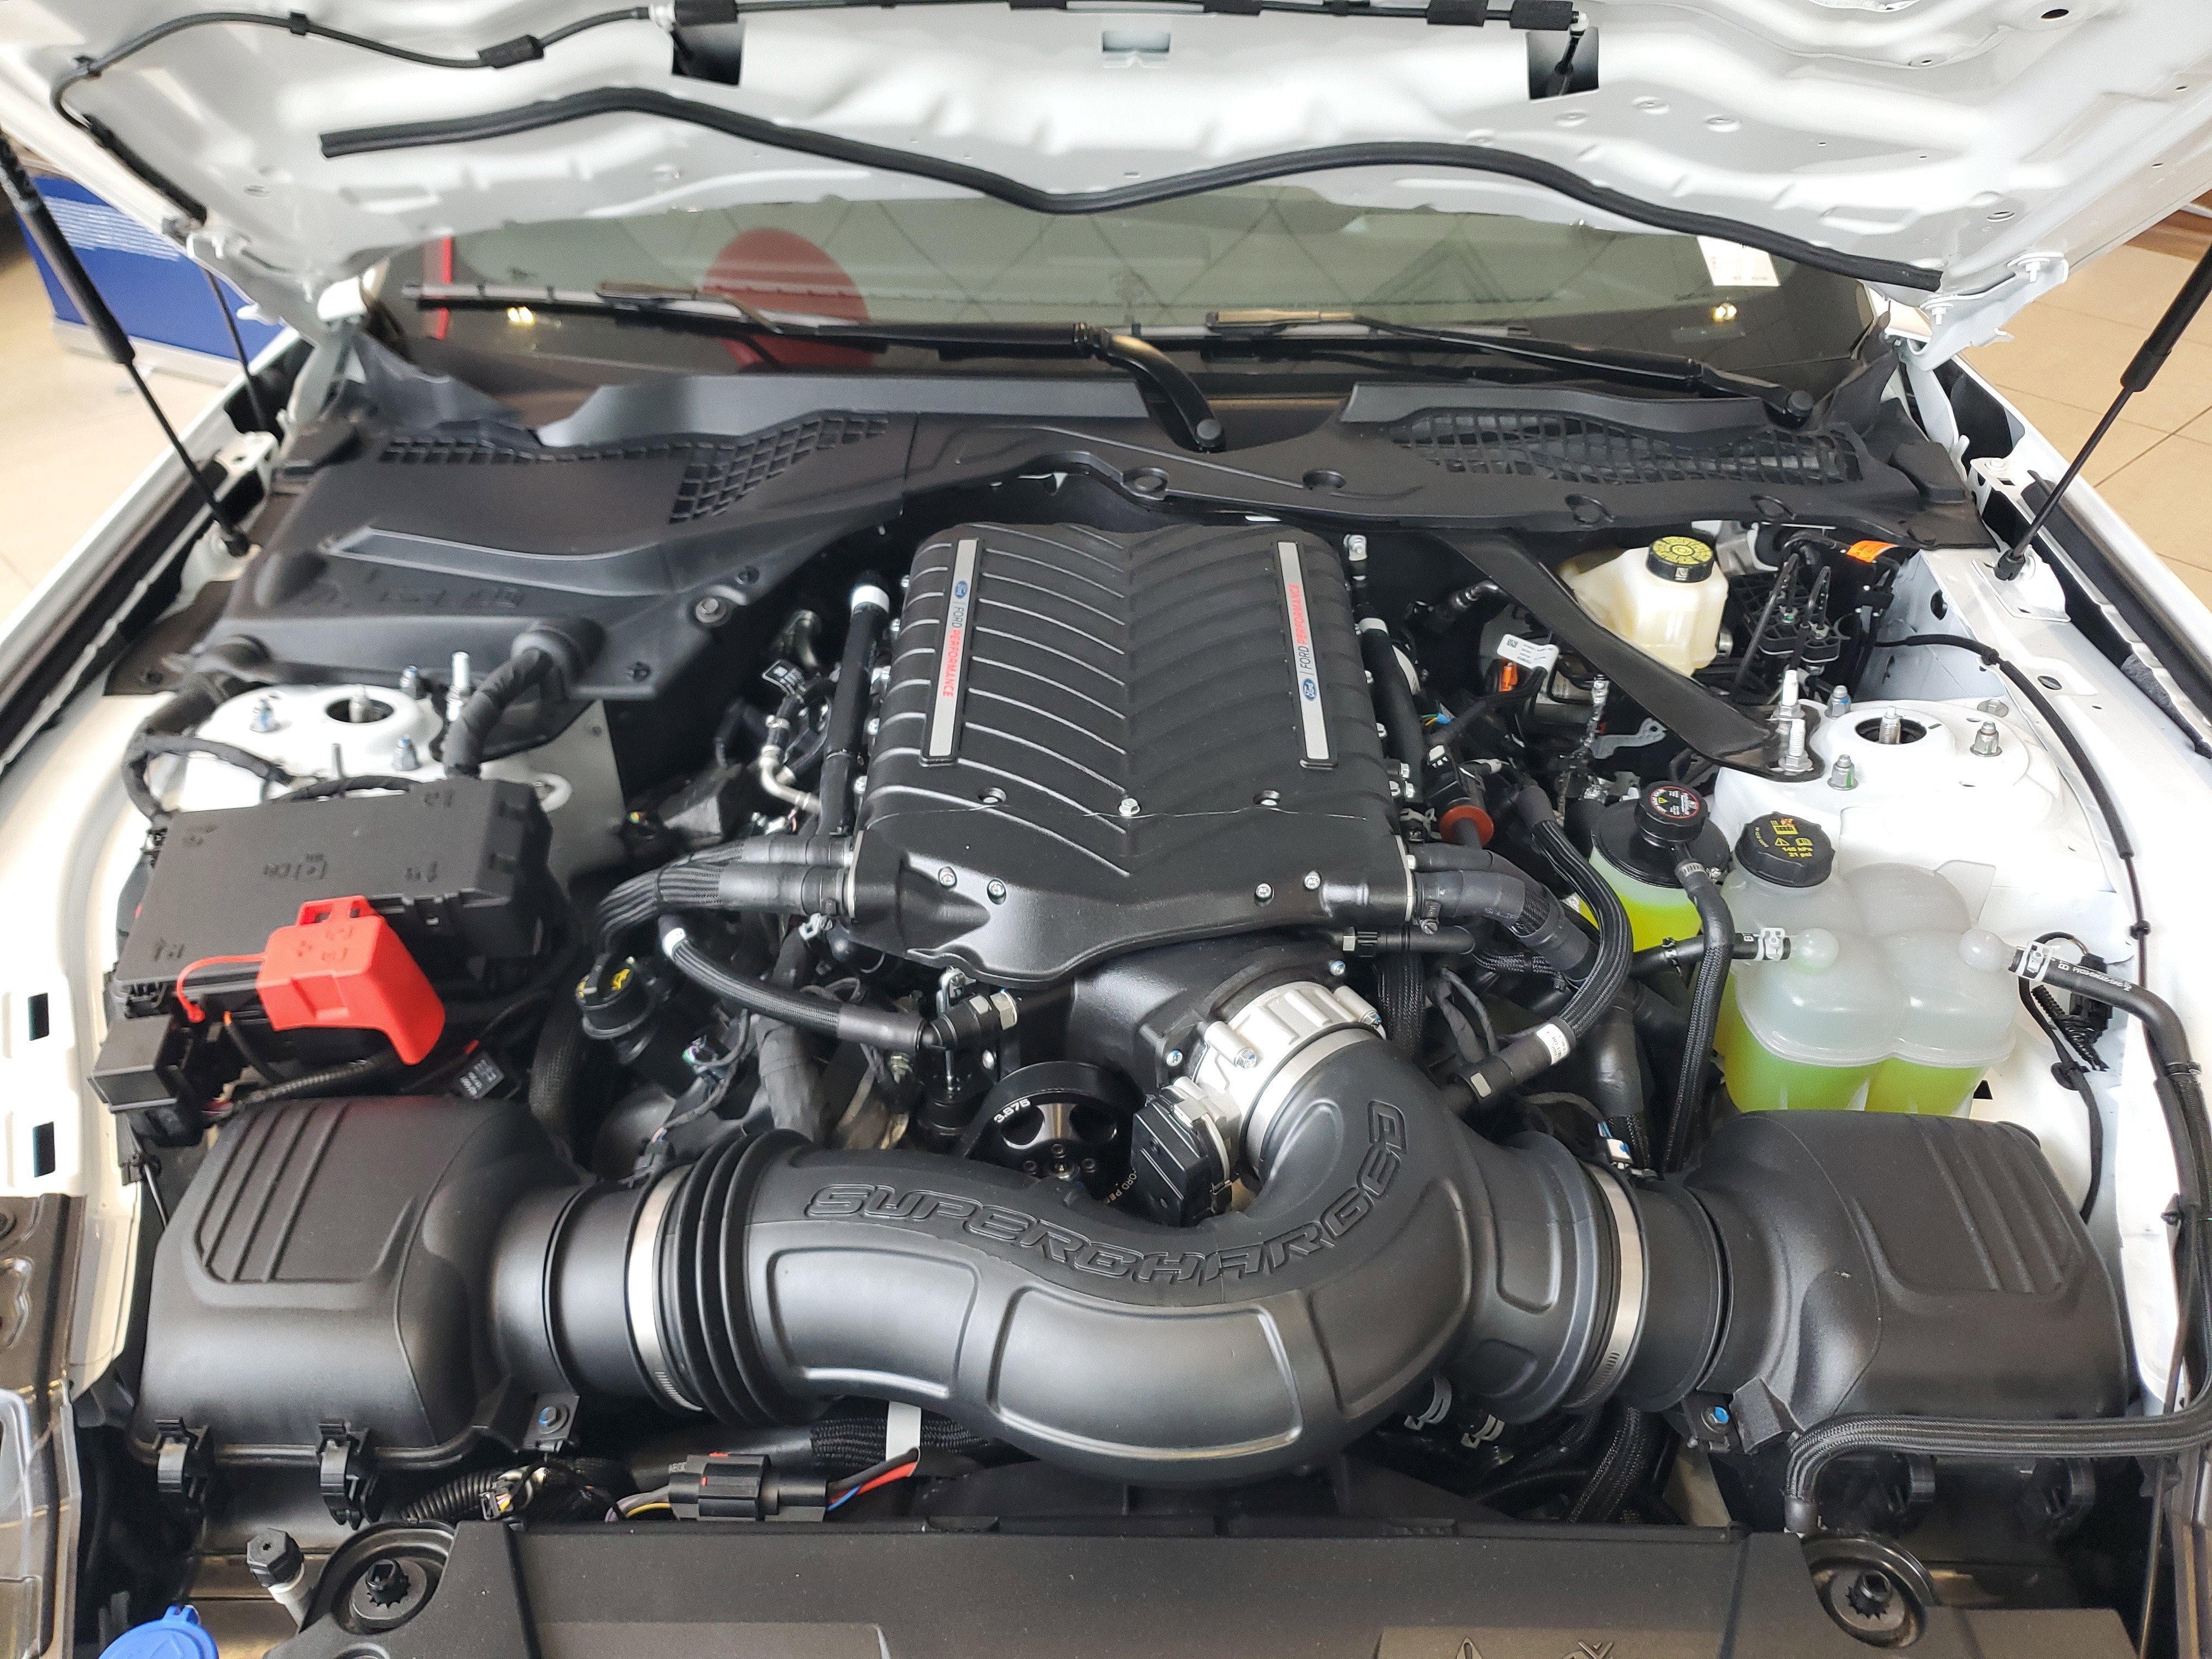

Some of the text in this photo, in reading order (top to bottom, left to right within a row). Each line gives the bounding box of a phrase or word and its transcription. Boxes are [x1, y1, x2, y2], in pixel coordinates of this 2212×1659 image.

[943, 629, 961, 697] PERFORMANCE
[952, 607, 964, 628] FORD
[1288, 584, 1316, 699] Ford FORD PERFORMANCE
[806, 1099, 1408, 1286] SUPERCHARGED
